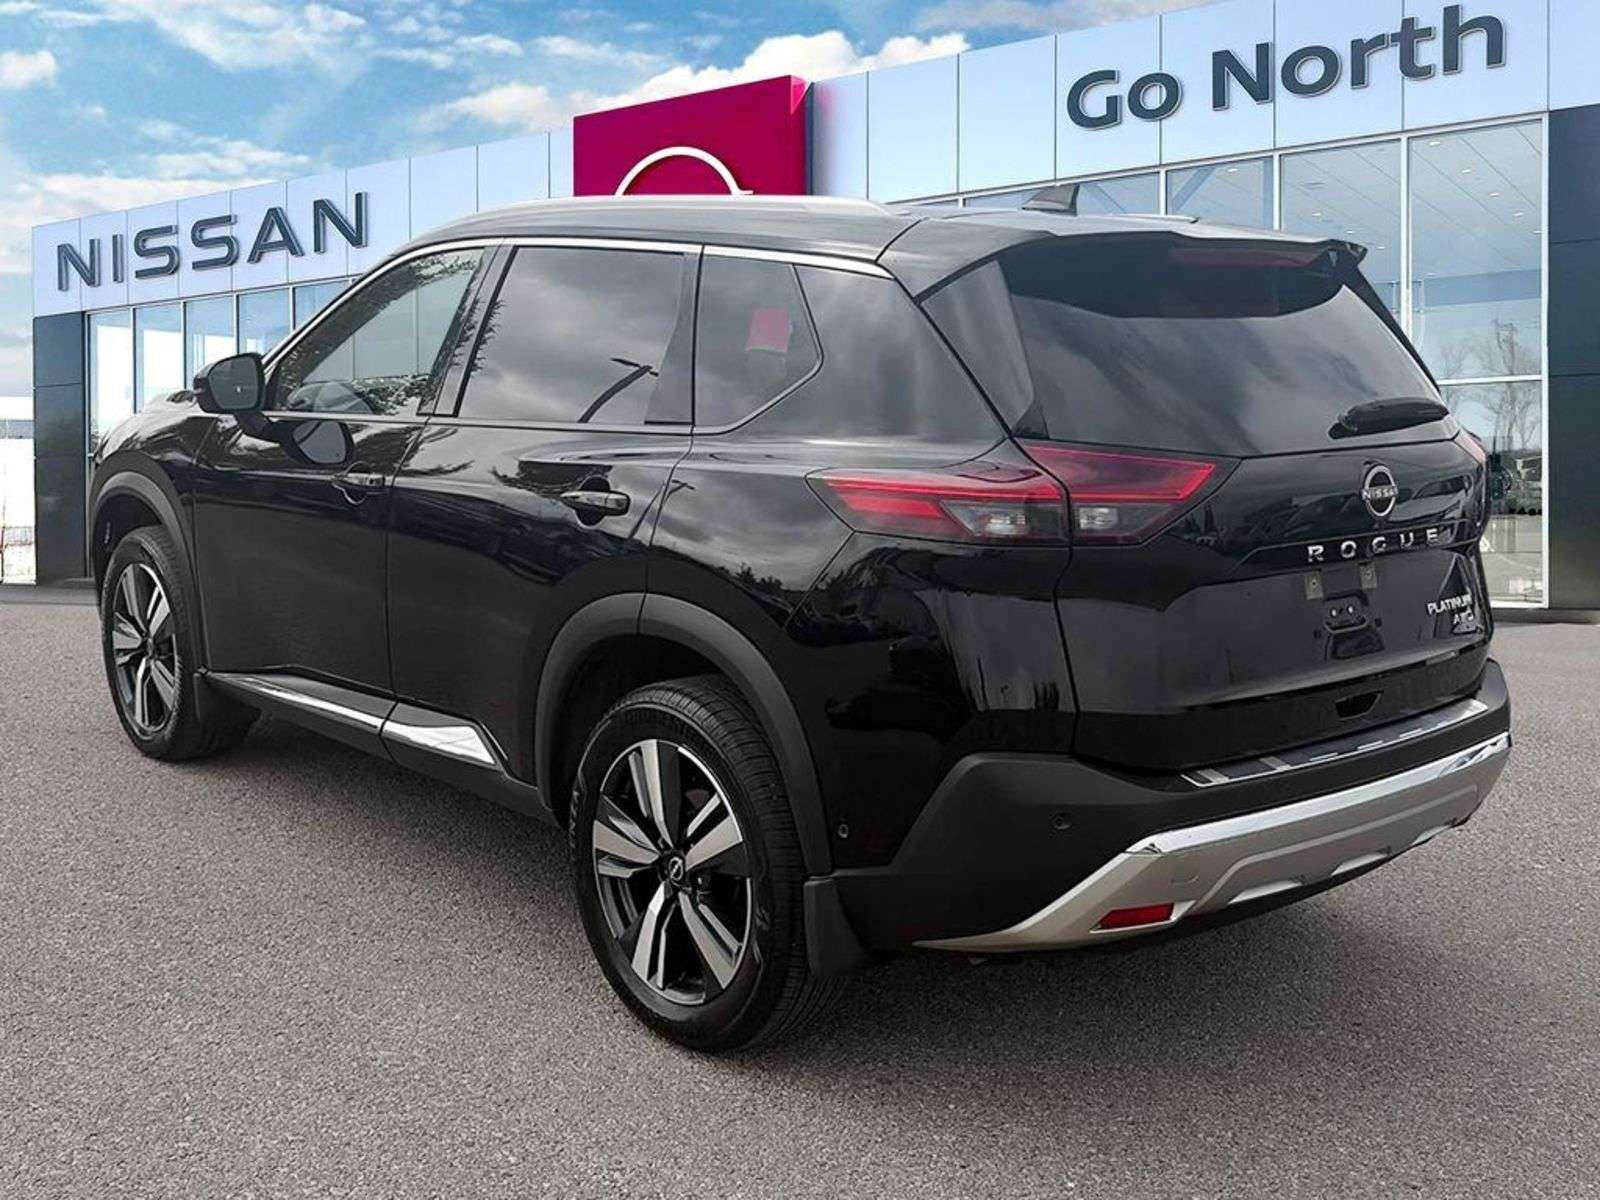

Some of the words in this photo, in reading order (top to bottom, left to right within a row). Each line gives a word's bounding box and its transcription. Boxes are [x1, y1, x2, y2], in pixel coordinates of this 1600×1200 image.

[1067, 70, 1182, 129] Go
[1211, 4, 1506, 111] North
[57, 192, 368, 291] NISSAN
[1307, 528, 1439, 562] ROGUE
